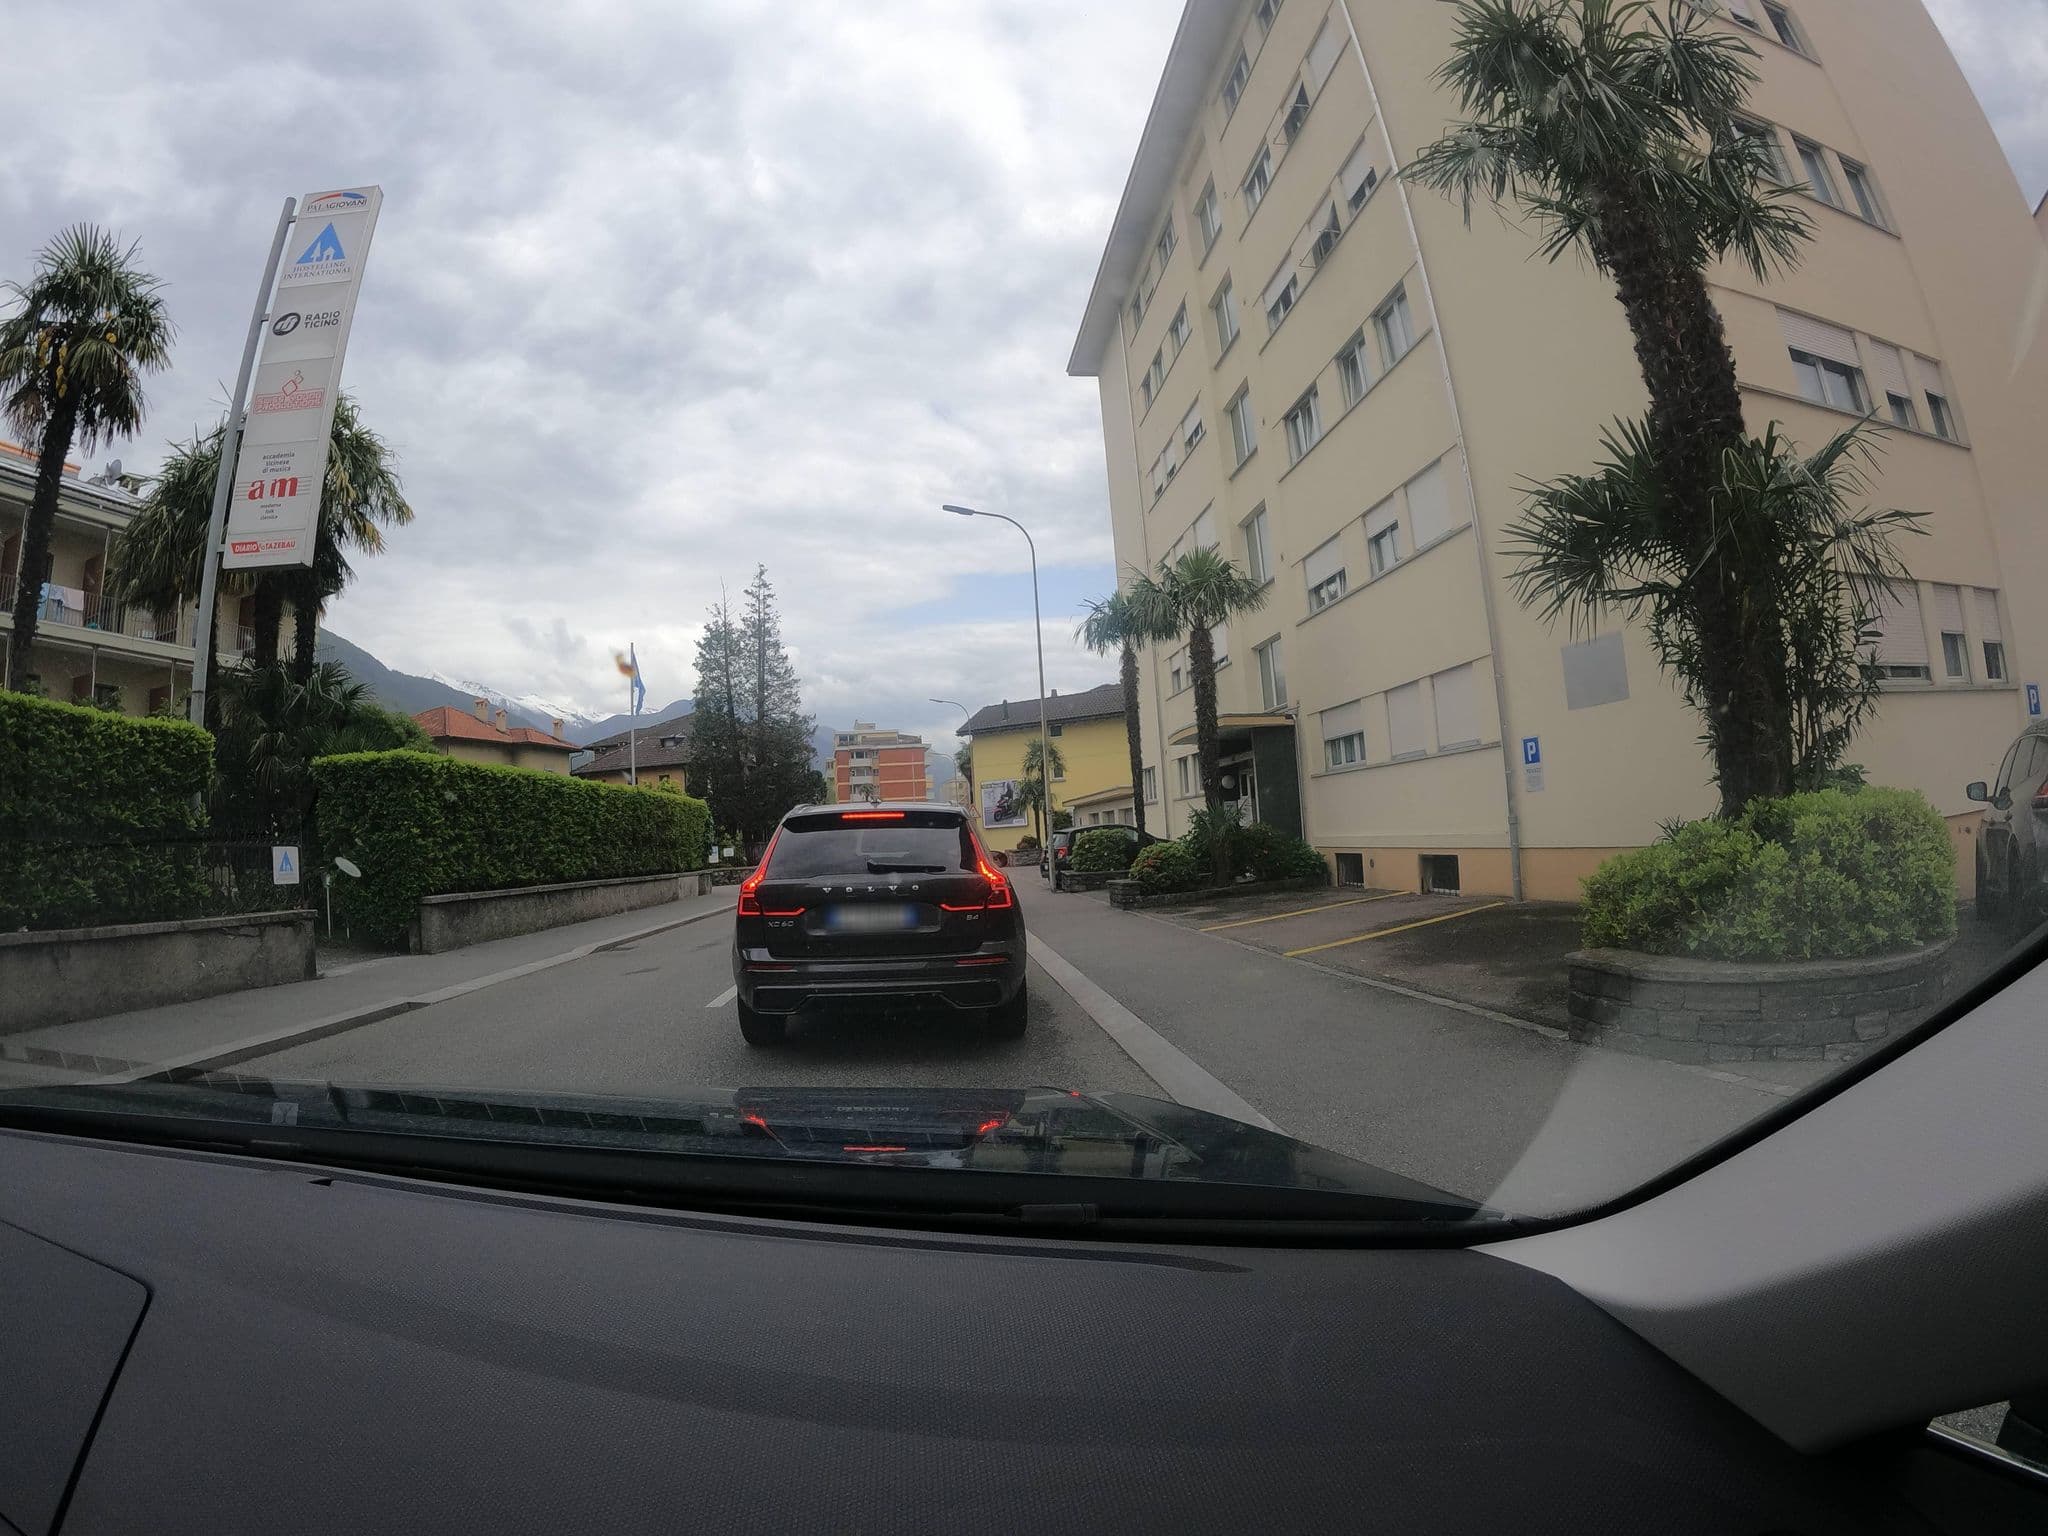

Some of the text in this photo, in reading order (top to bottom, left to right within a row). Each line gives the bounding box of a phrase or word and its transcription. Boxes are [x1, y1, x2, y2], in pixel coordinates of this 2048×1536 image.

[306, 199, 368, 212] PALAGIOVANI
[293, 261, 345, 273] HOSTELLING
[283, 267, 351, 280] INTERNATIONAL
[304, 310, 341, 321] RADIO
[304, 318, 339, 329] TICINO
[262, 451, 295, 460] accademia
[234, 543, 258, 553] DIARIO
[1526, 741, 1537, 762] P
[822, 884, 920, 894] VOLVO
[767, 920, 794, 928] XC60
